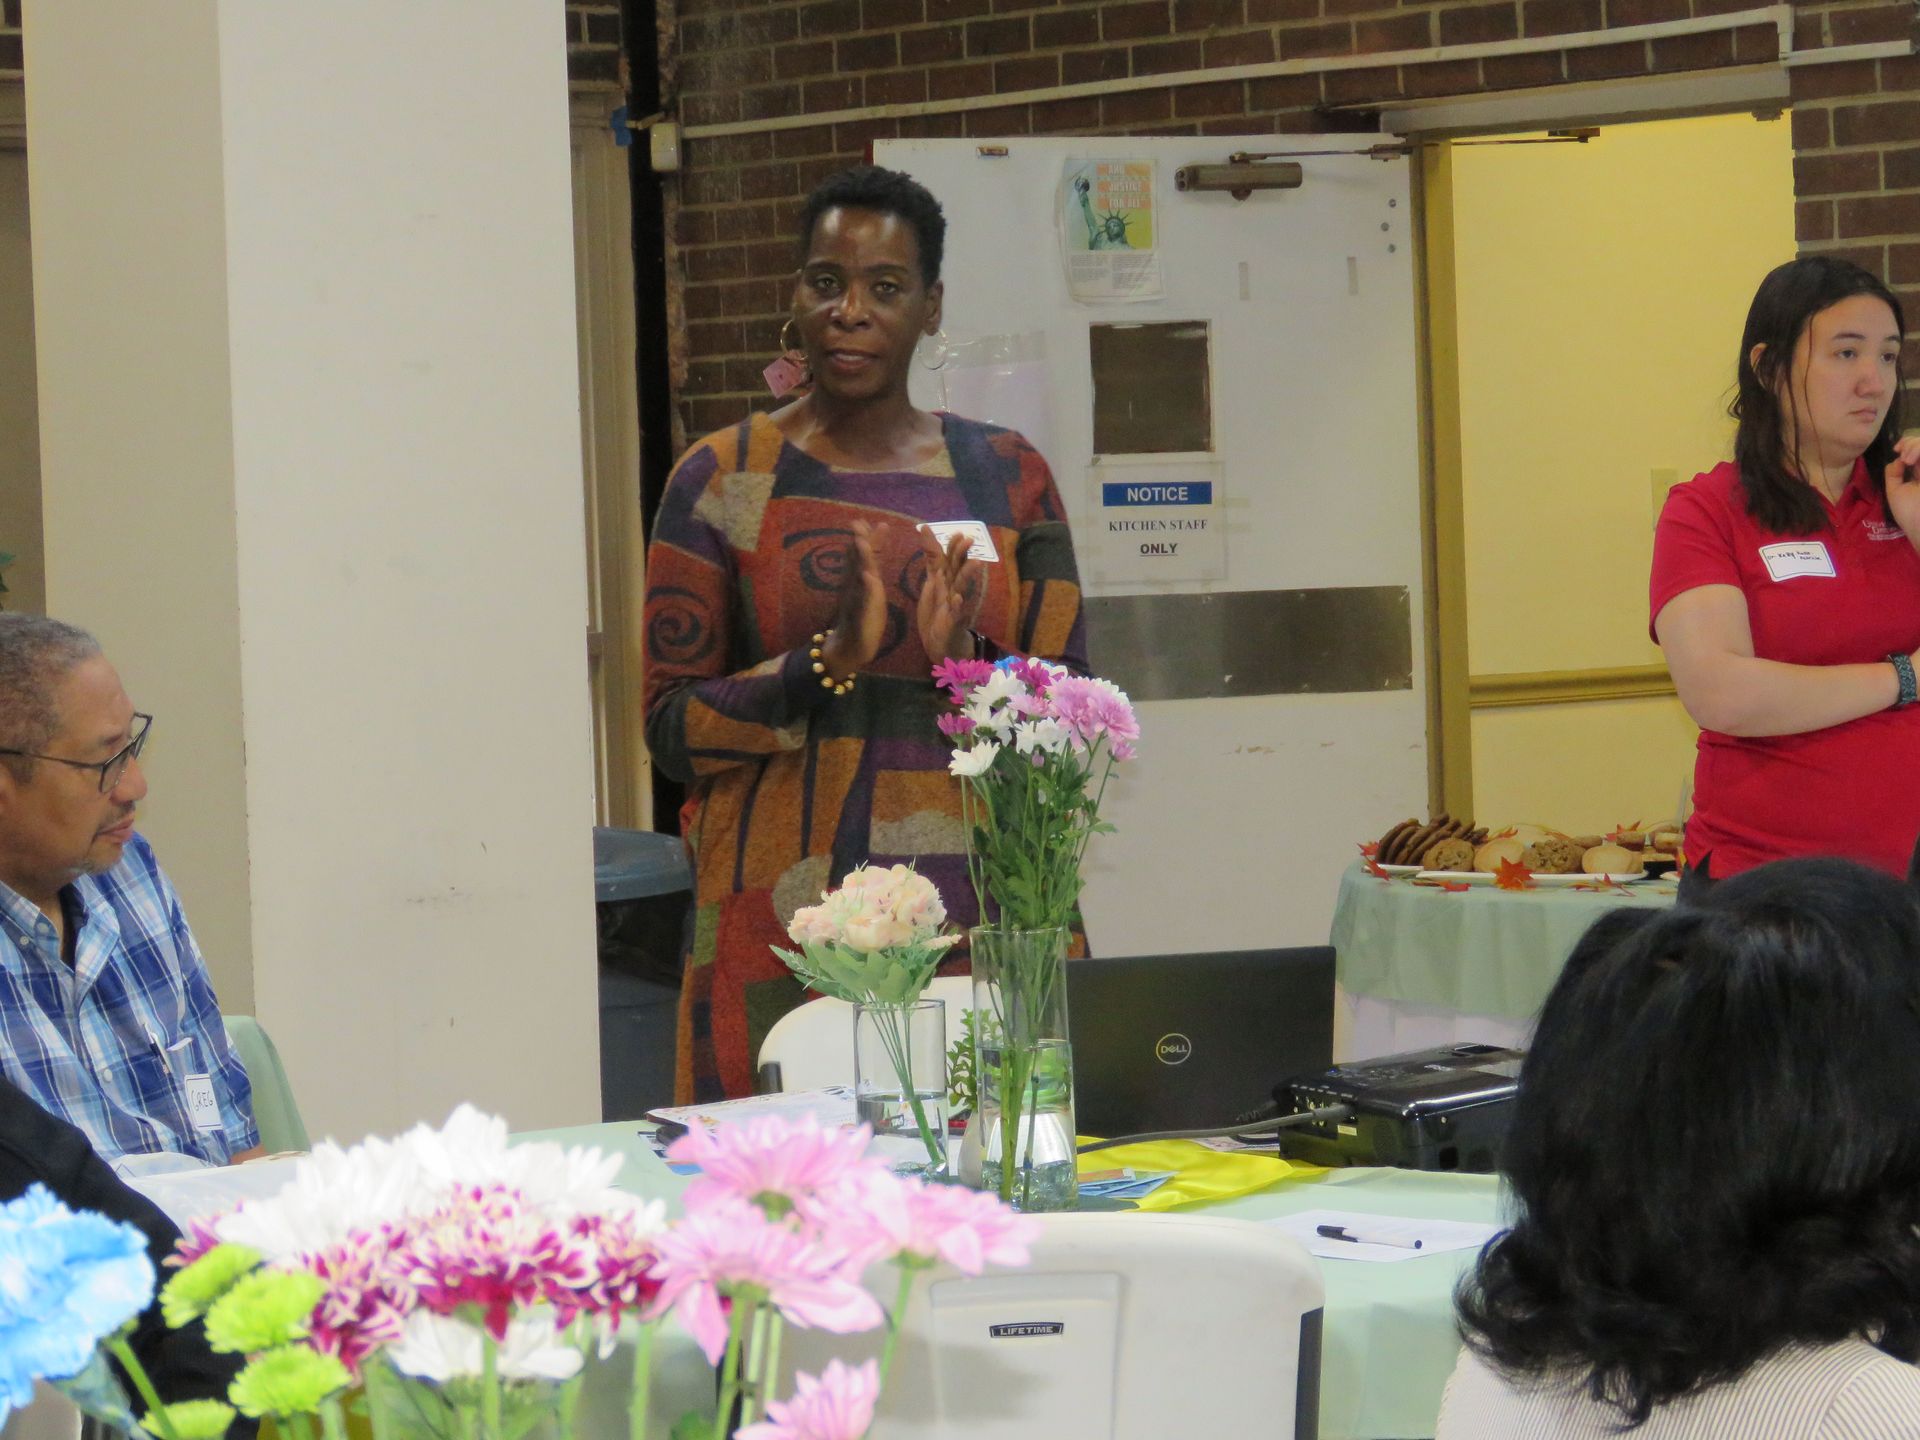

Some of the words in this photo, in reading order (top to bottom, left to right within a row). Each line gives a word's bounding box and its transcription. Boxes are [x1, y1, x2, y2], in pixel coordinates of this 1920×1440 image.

[1127, 486, 1189, 502] NOTICE
[1108, 520, 1167, 532] KITCHEN
[1169, 519, 1208, 530] STAFF
[1139, 543, 1178, 555] ONLY
[999, 1326, 1054, 1336] LIFETIME
